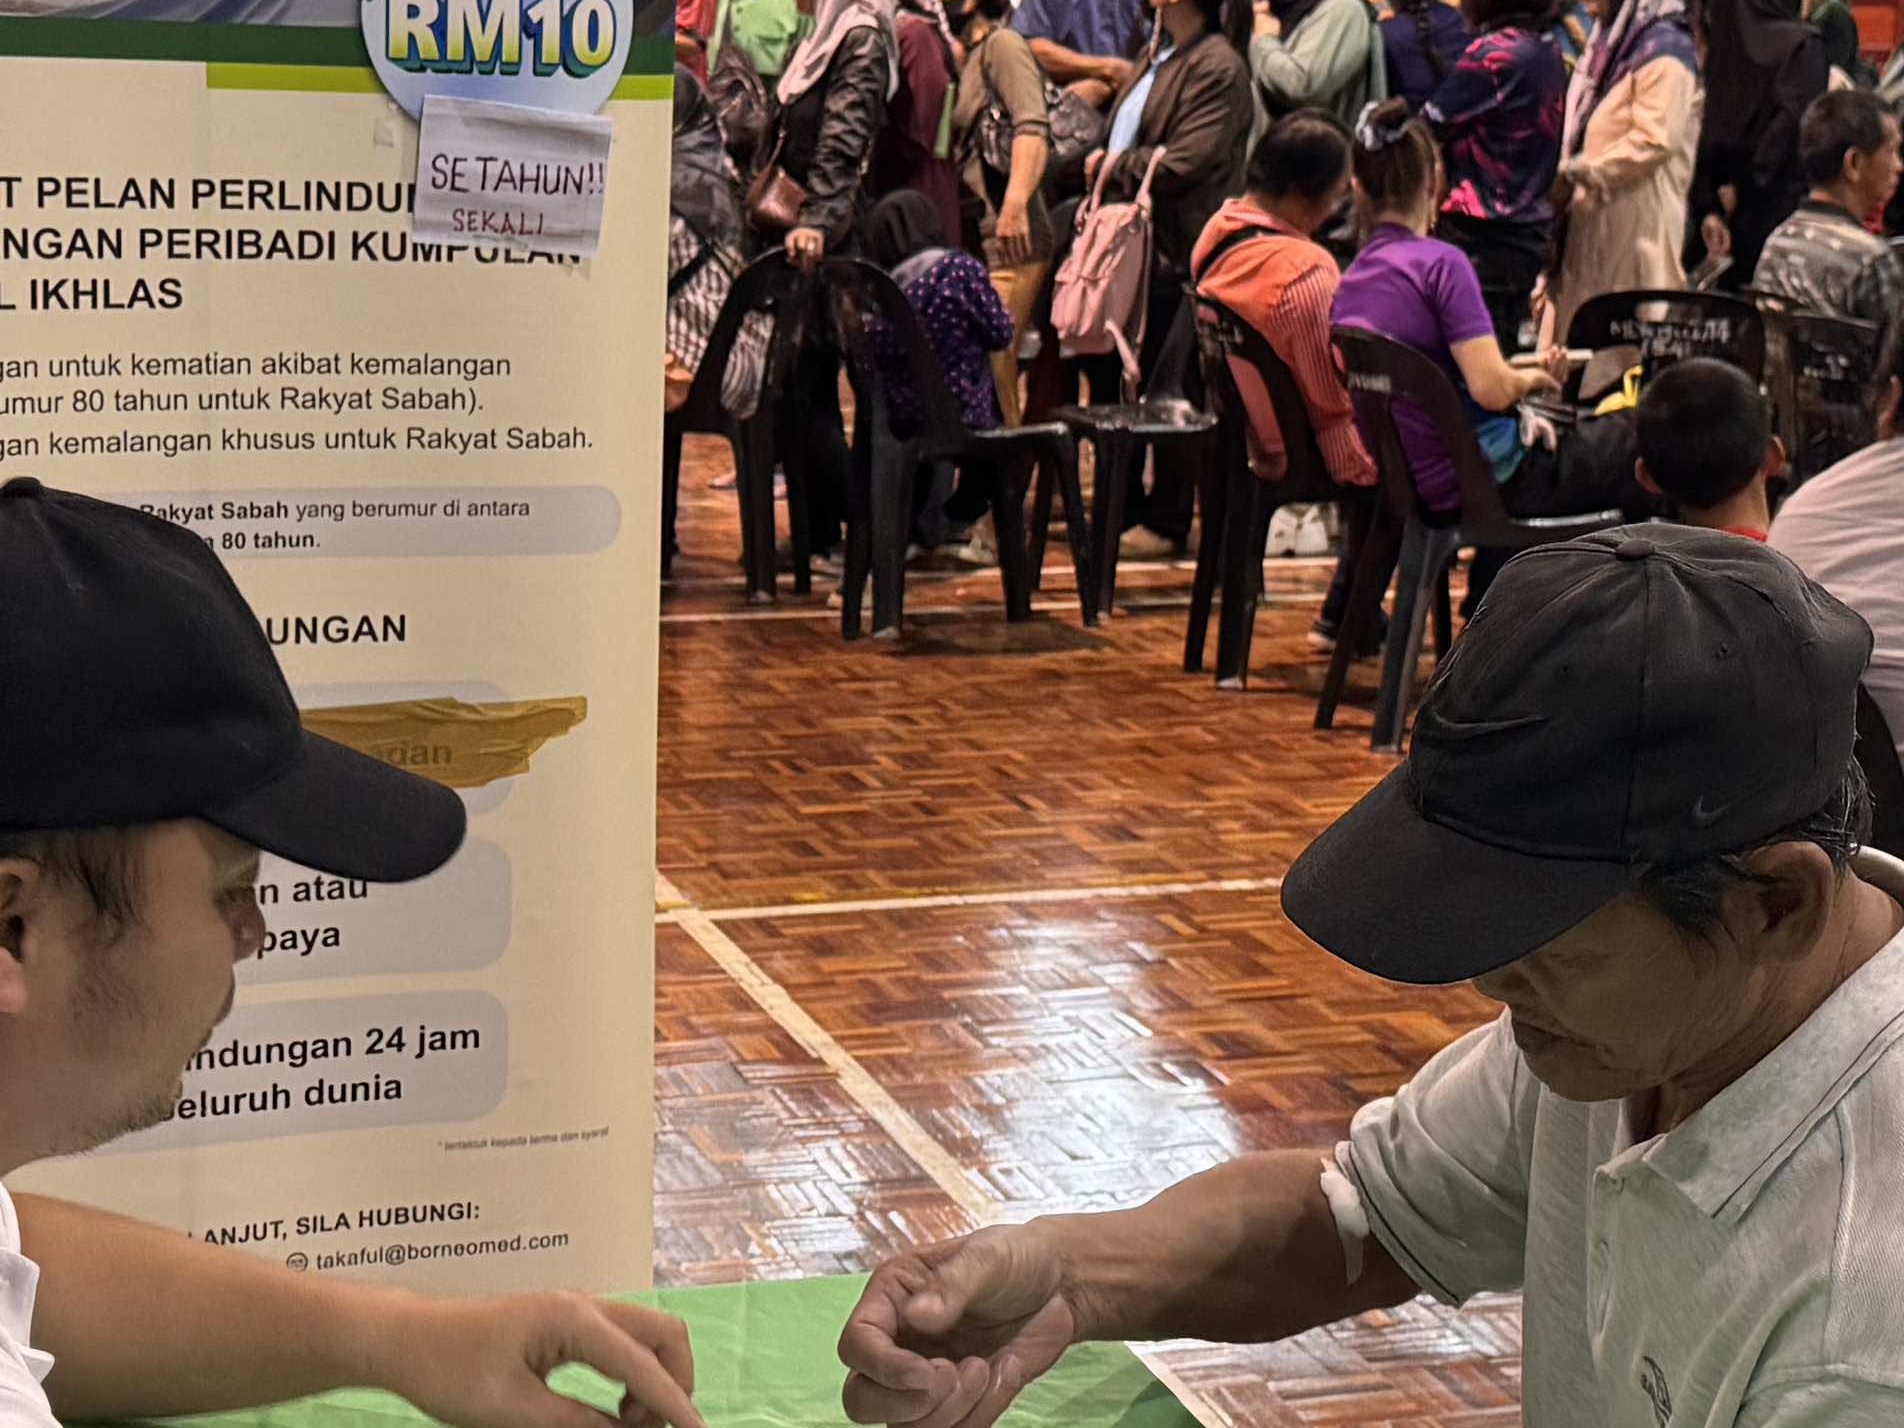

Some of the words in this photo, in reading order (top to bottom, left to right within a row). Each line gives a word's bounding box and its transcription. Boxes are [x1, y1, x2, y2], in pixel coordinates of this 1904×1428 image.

[37, 178, 176, 211] PELAN
[192, 179, 415, 214] PERLINDU
[451, 207, 544, 236] SEKALI
[139, 228, 335, 264] PERIBADI
[30, 277, 184, 310] IKHLAS
[48, 352, 123, 379] untuk
[131, 351, 253, 377] kematian
[261, 350, 341, 377] akibat
[349, 351, 512, 381] kemalangan
[72, 389, 105, 414] 80
[113, 388, 189, 413] tahun
[197, 386, 271, 411] untuk
[280, 386, 373, 417] Rakyat
[382, 386, 484, 417] Sabah).
[48, 430, 212, 459] kemalangan
[221, 428, 315, 453] khusus
[324, 426, 397, 451] untuk
[405, 426, 497, 456] Rakyat
[506, 425, 594, 451] Sabah.
[221, 502, 288, 520] Sabah
[296, 504, 345, 522] yang
[352, 501, 437, 517] berumur
[443, 500, 460, 516] di
[467, 500, 530, 517] antara
[221, 532, 246, 550] 80
[253, 532, 320, 549] tahun.
[293, 874, 368, 904] atau
[365, 1026, 406, 1056] 24
[415, 1024, 480, 1059] jam
[304, 1074, 403, 1107] dunia
[188, 1219, 288, 1247] ANJUT,
[296, 1211, 352, 1236] SILA
[358, 1202, 480, 1230] HUBUNGI:
[316, 1231, 570, 1272] takaful@borneomed.com
